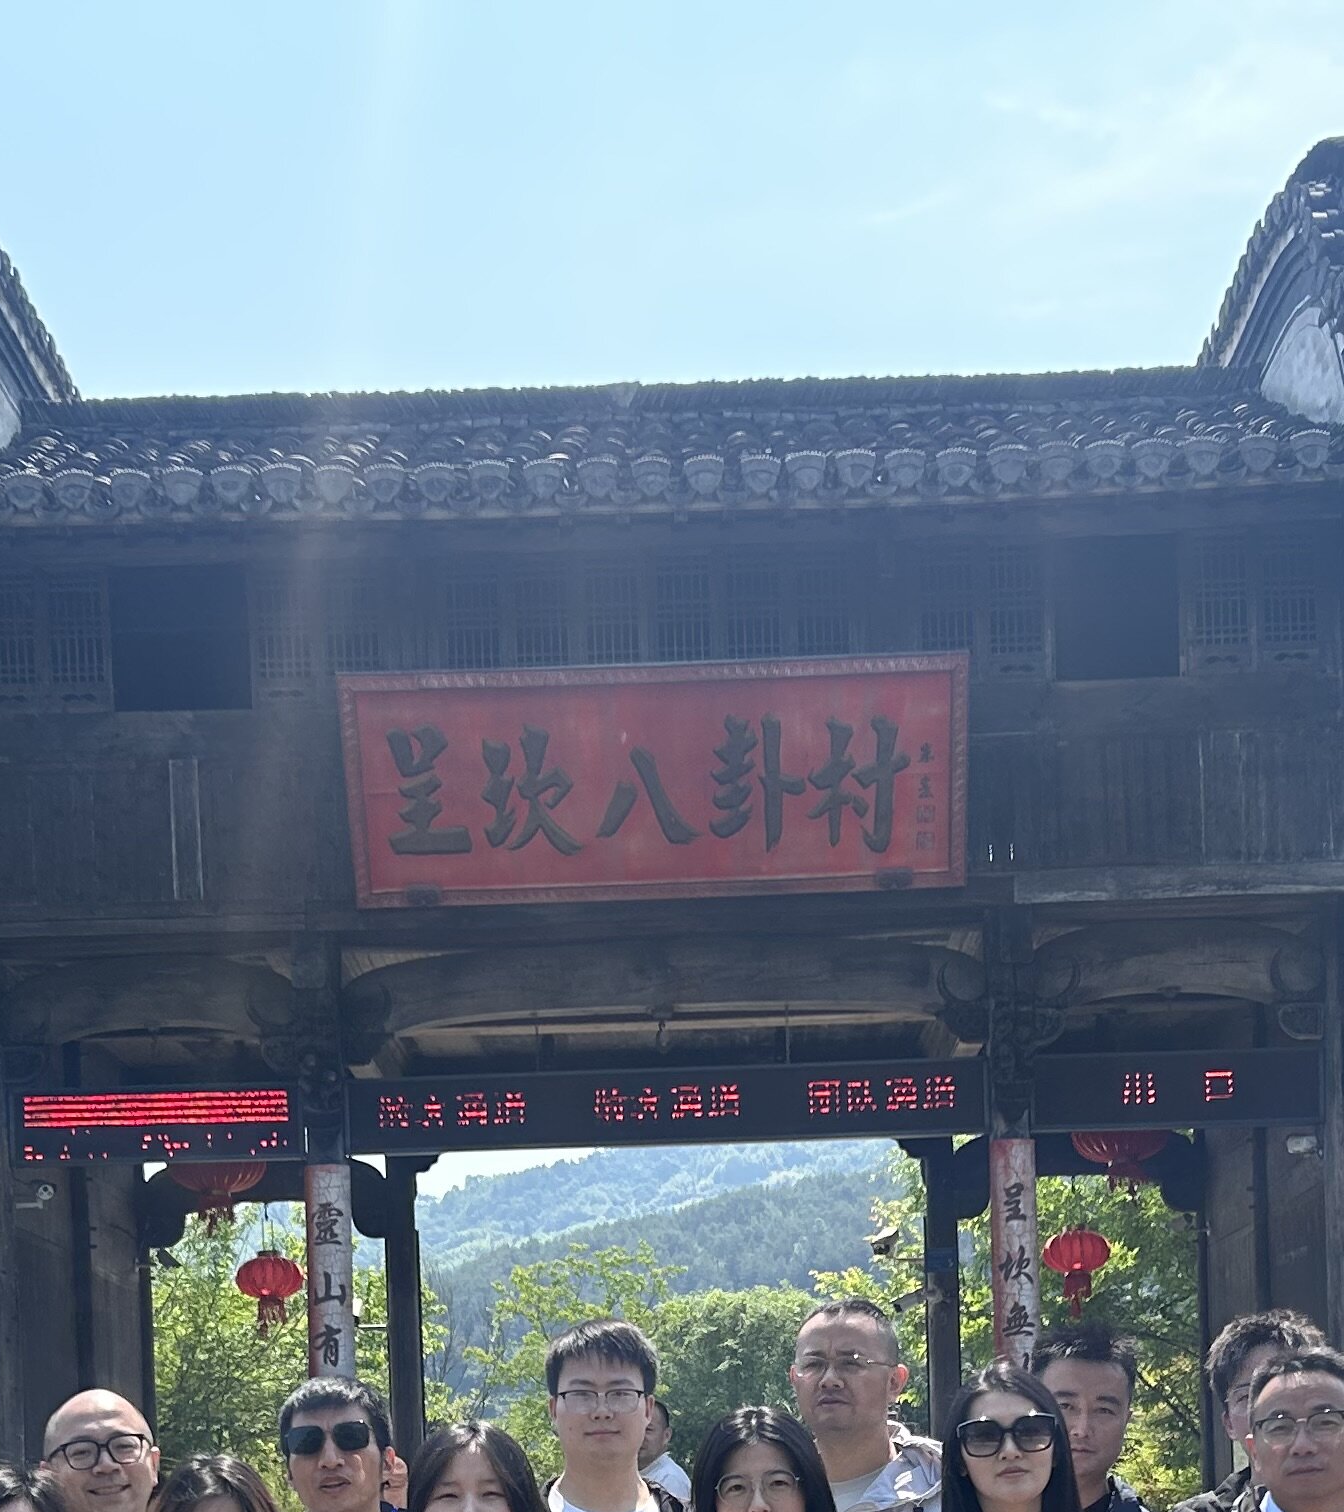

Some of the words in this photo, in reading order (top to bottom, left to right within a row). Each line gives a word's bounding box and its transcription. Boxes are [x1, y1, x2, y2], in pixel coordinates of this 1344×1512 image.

[387, 712, 911, 856] 呈坎八卦村
[311, 1202, 347, 1368] 靈山有
[998, 1182, 1036, 1372] 呈坎無
